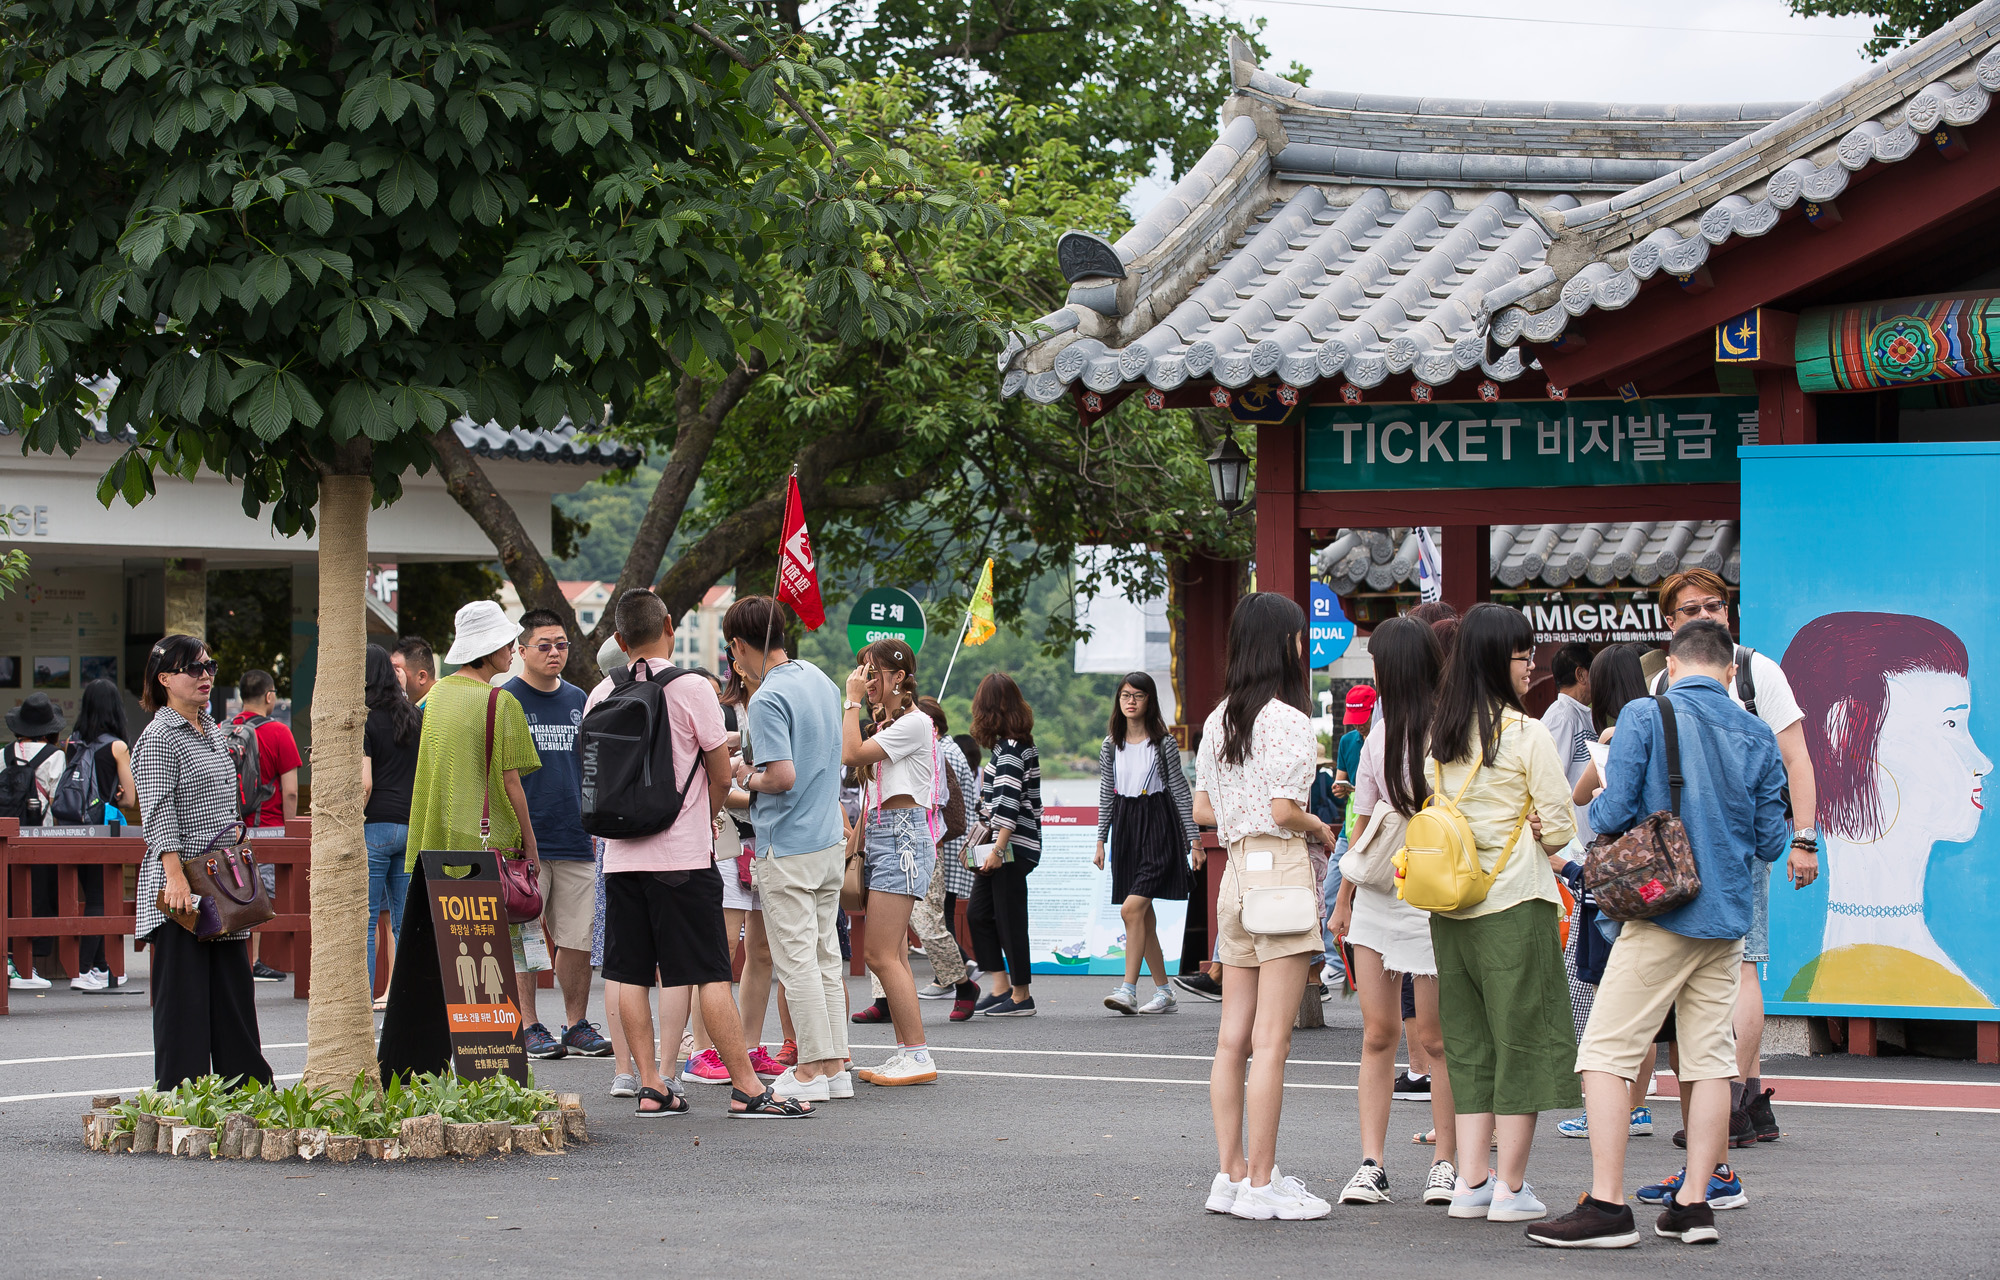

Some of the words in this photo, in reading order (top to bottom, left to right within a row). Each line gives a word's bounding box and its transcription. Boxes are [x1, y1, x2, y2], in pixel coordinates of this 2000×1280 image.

[1333, 418, 1521, 464] TICKET
[1537, 412, 1717, 463] 비자발급
[0, 504, 48, 537] GE
[870, 603, 904, 622] 단체
[1313, 598, 1330, 617] 인
[1522, 603, 1664, 631] MIGRATI
[866, 630, 906, 643] GROUP
[528, 724, 579, 734] MASSACHUSETTS
[535, 733, 567, 742] INSTITUTE
[567, 734, 575, 743] OF
[538, 741, 573, 751] TECHNOLOGY
[583, 740, 600, 786] PUMA
[66, 828, 87, 836] REPUBLIC
[438, 896, 498, 921] TOILET
[492, 1009, 516, 1024] 10m
[457, 1045, 477, 1055] Behind
[478, 1045, 488, 1055] the
[487, 1045, 506, 1055] Ticket
[505, 1044, 523, 1054] Office
